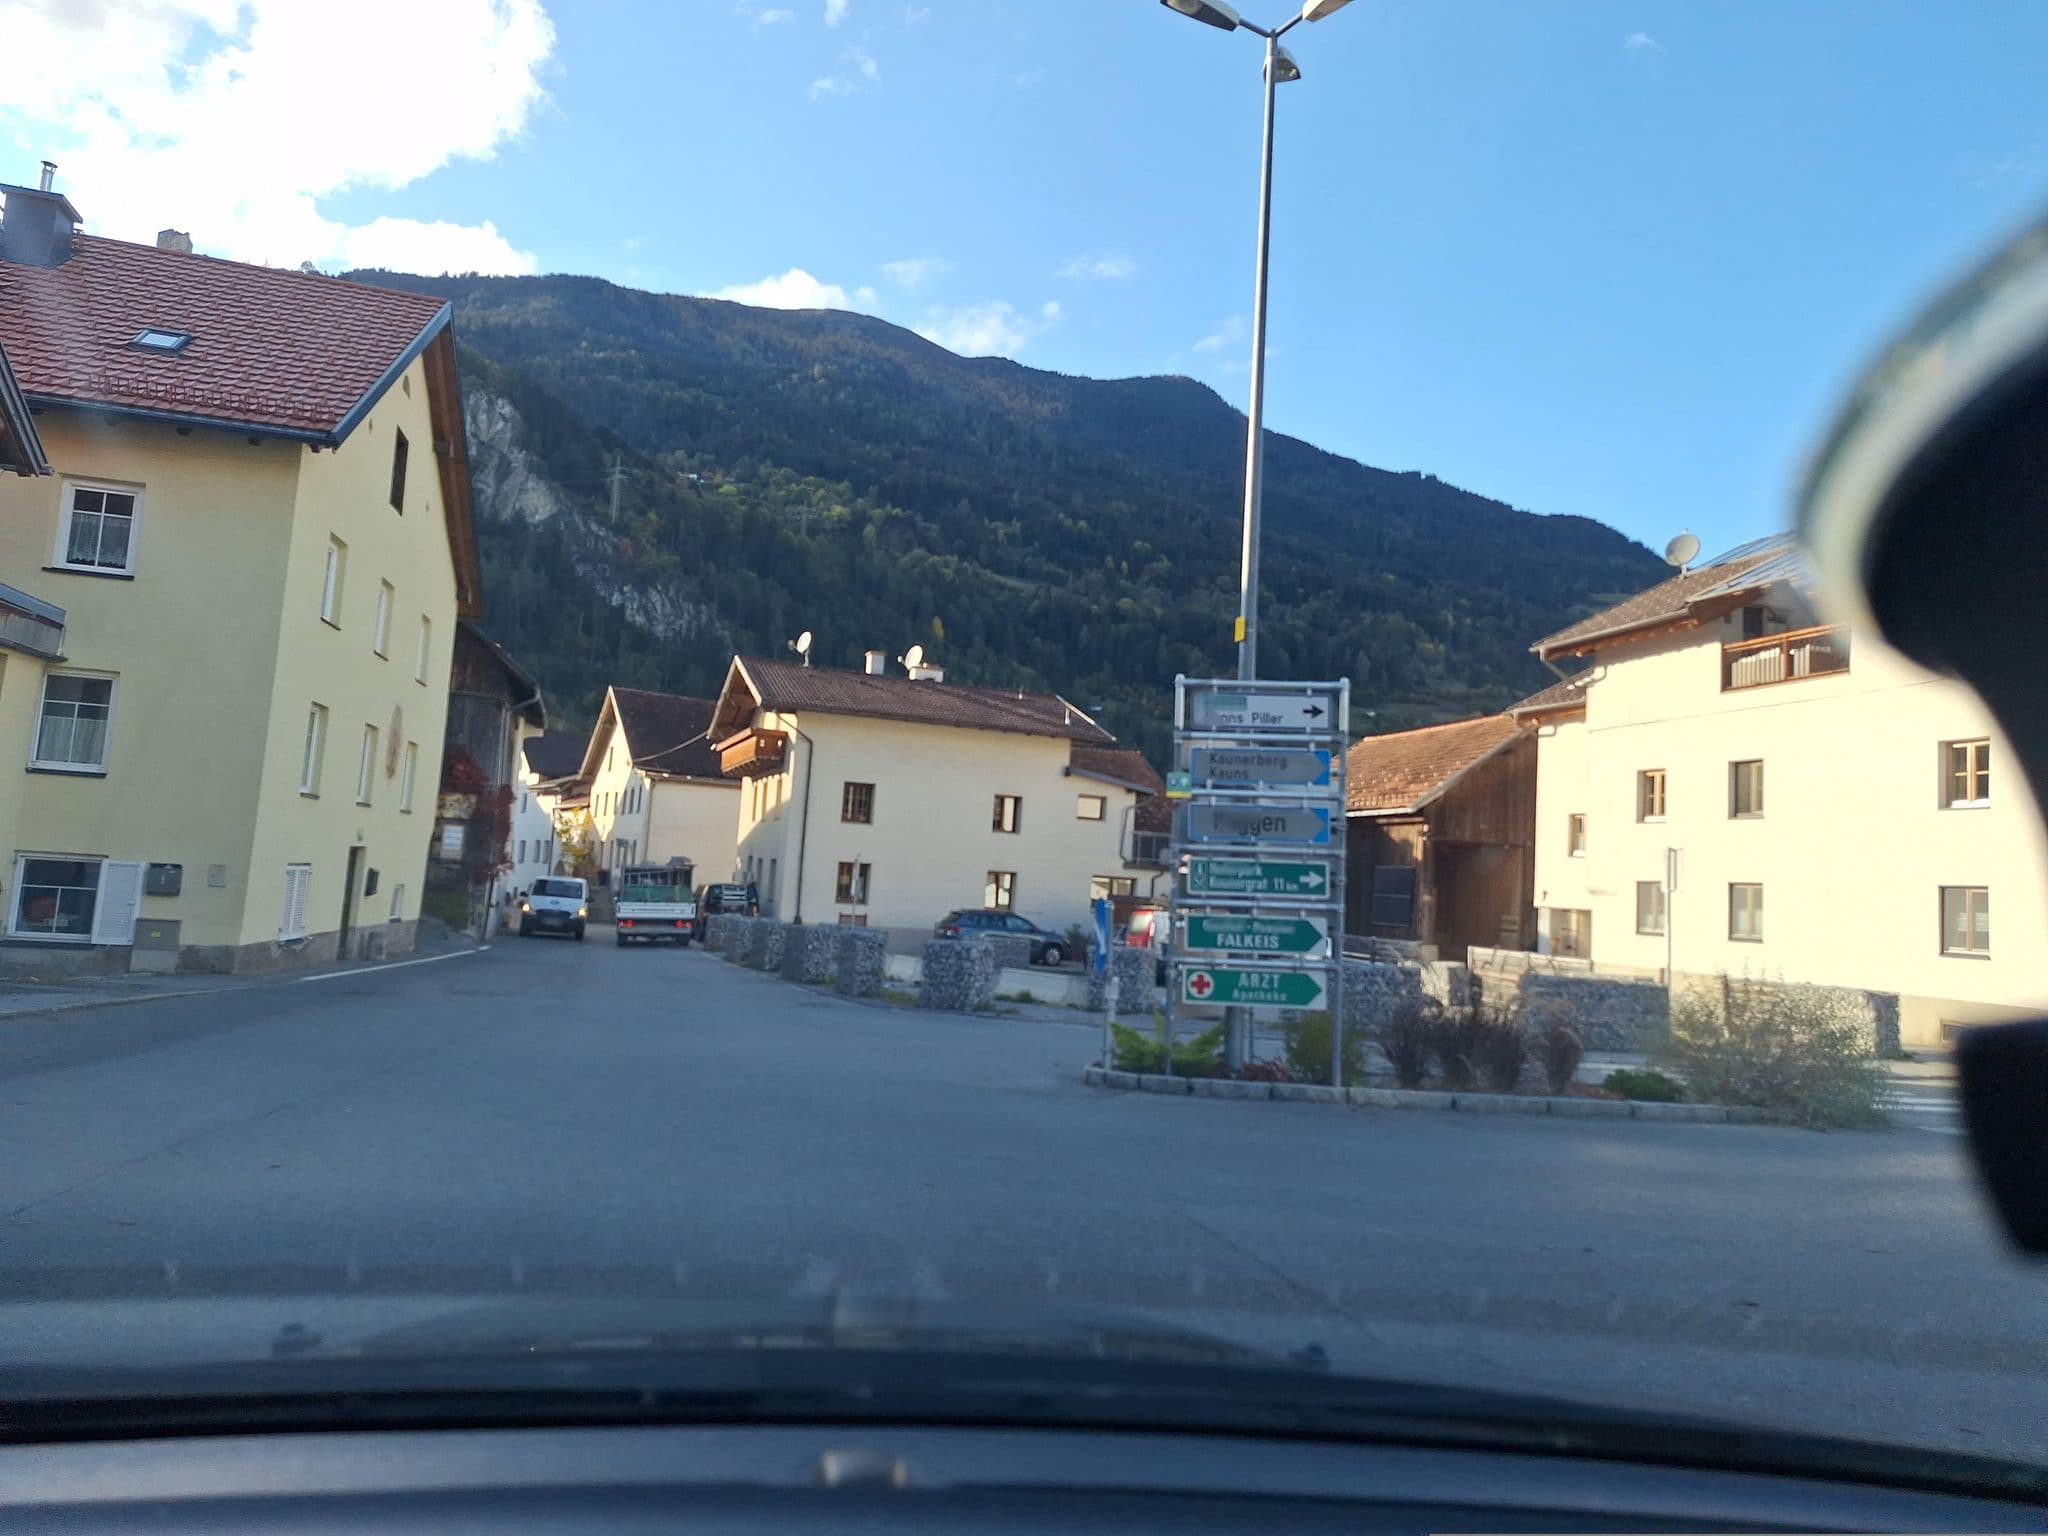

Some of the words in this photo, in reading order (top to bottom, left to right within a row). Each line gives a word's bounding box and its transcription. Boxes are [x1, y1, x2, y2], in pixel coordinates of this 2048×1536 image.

[1252, 712, 1284, 724] Piller
[1209, 752, 1288, 769] Kaunerberg
[1209, 766, 1249, 778] Kauns
[1274, 877, 1285, 890] 11
[1217, 933, 1279, 948] FALKEIS
[1238, 973, 1281, 989] ARZT
